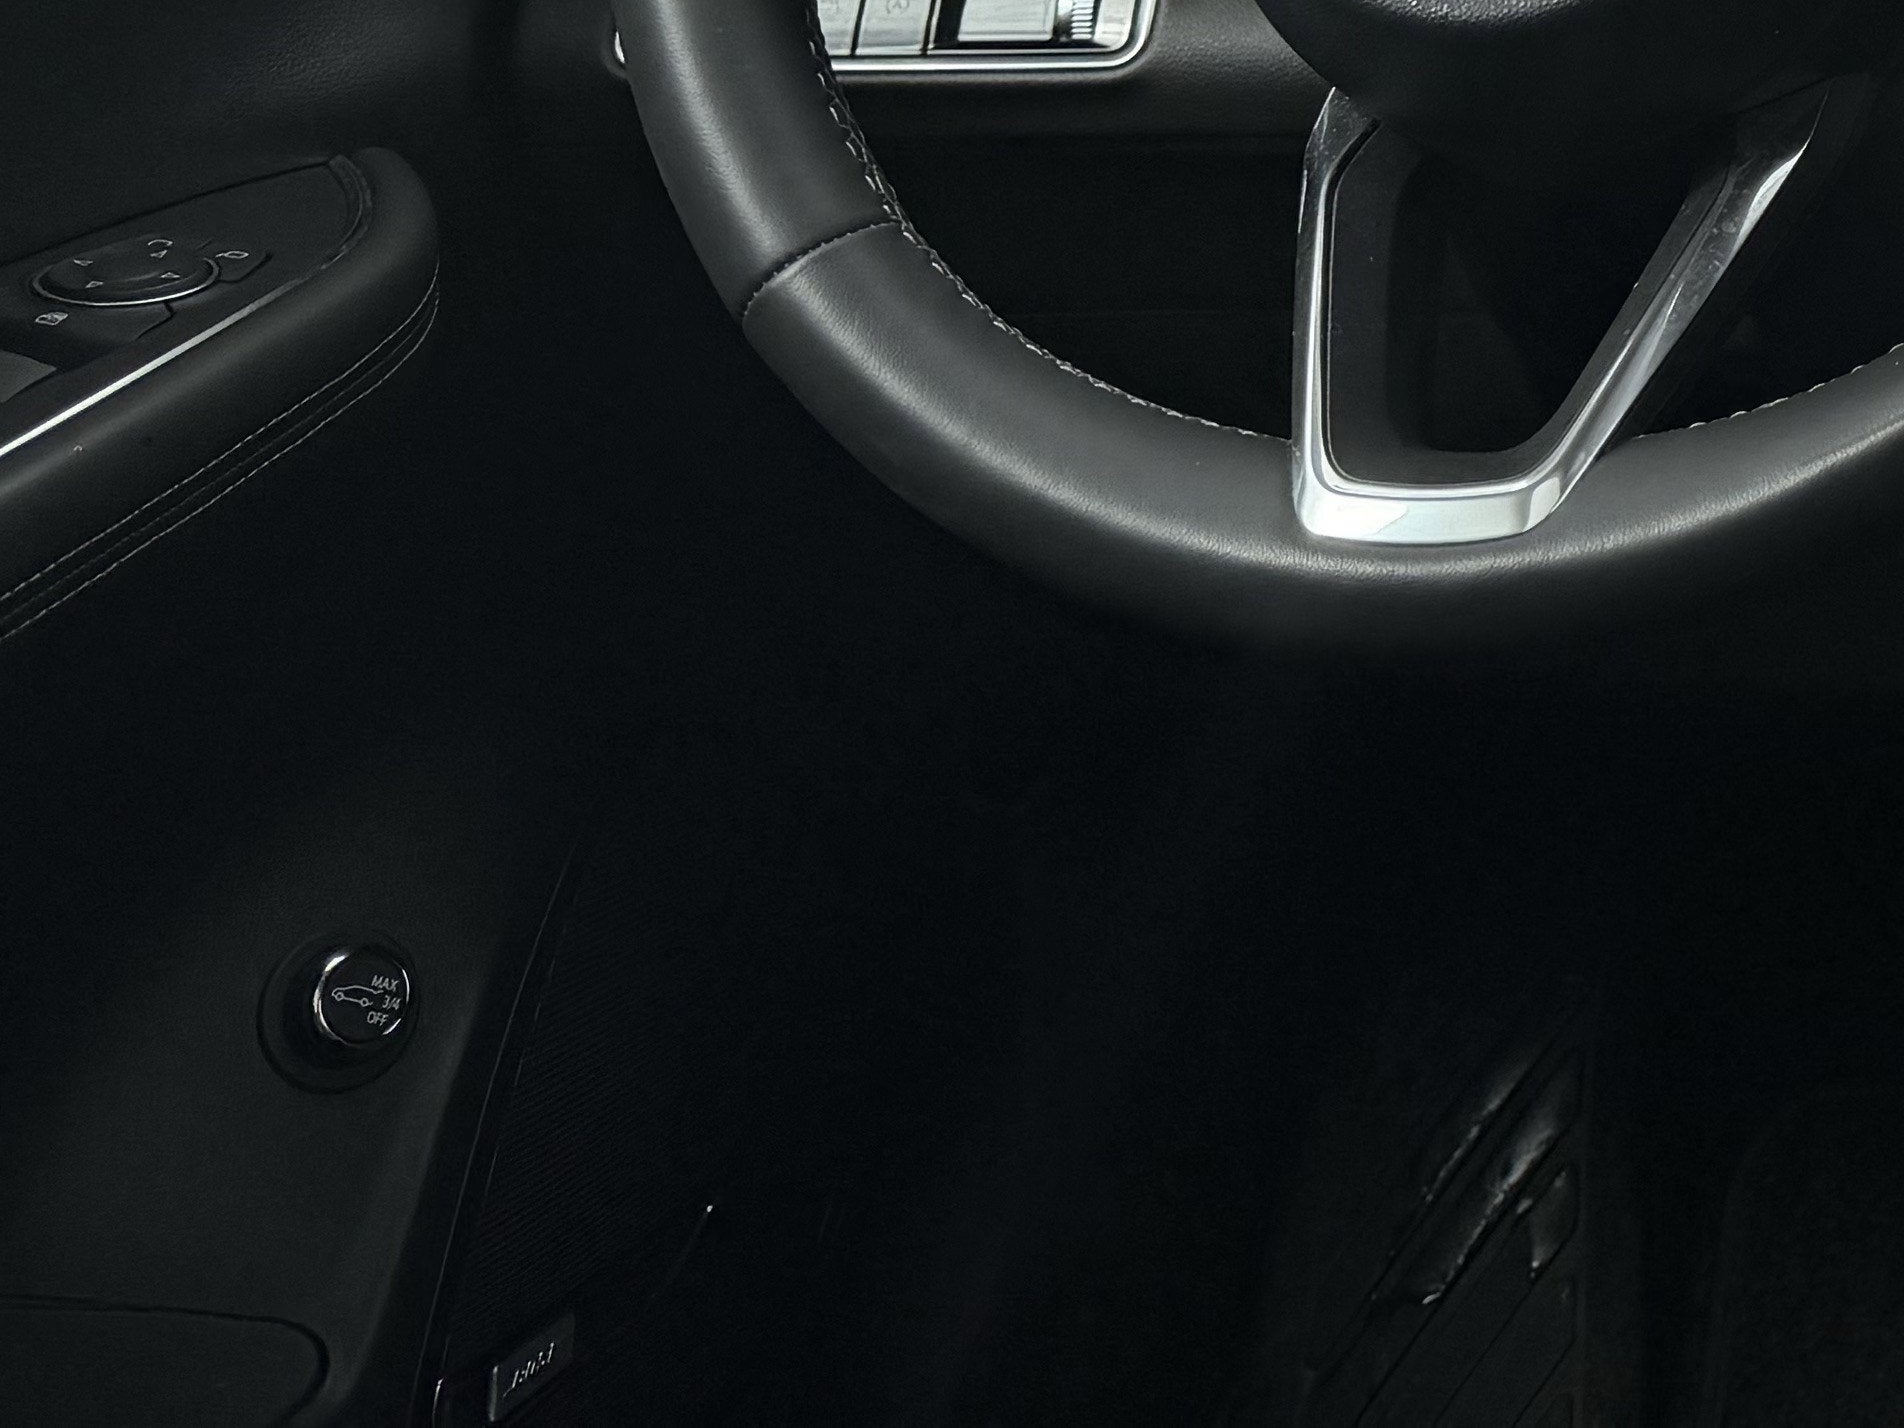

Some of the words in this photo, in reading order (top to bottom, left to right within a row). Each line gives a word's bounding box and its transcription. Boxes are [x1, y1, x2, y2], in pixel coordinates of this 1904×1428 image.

[371, 974, 400, 993] MAX
[382, 994, 401, 1011] 3/4
[367, 1010, 389, 1026] OFF
